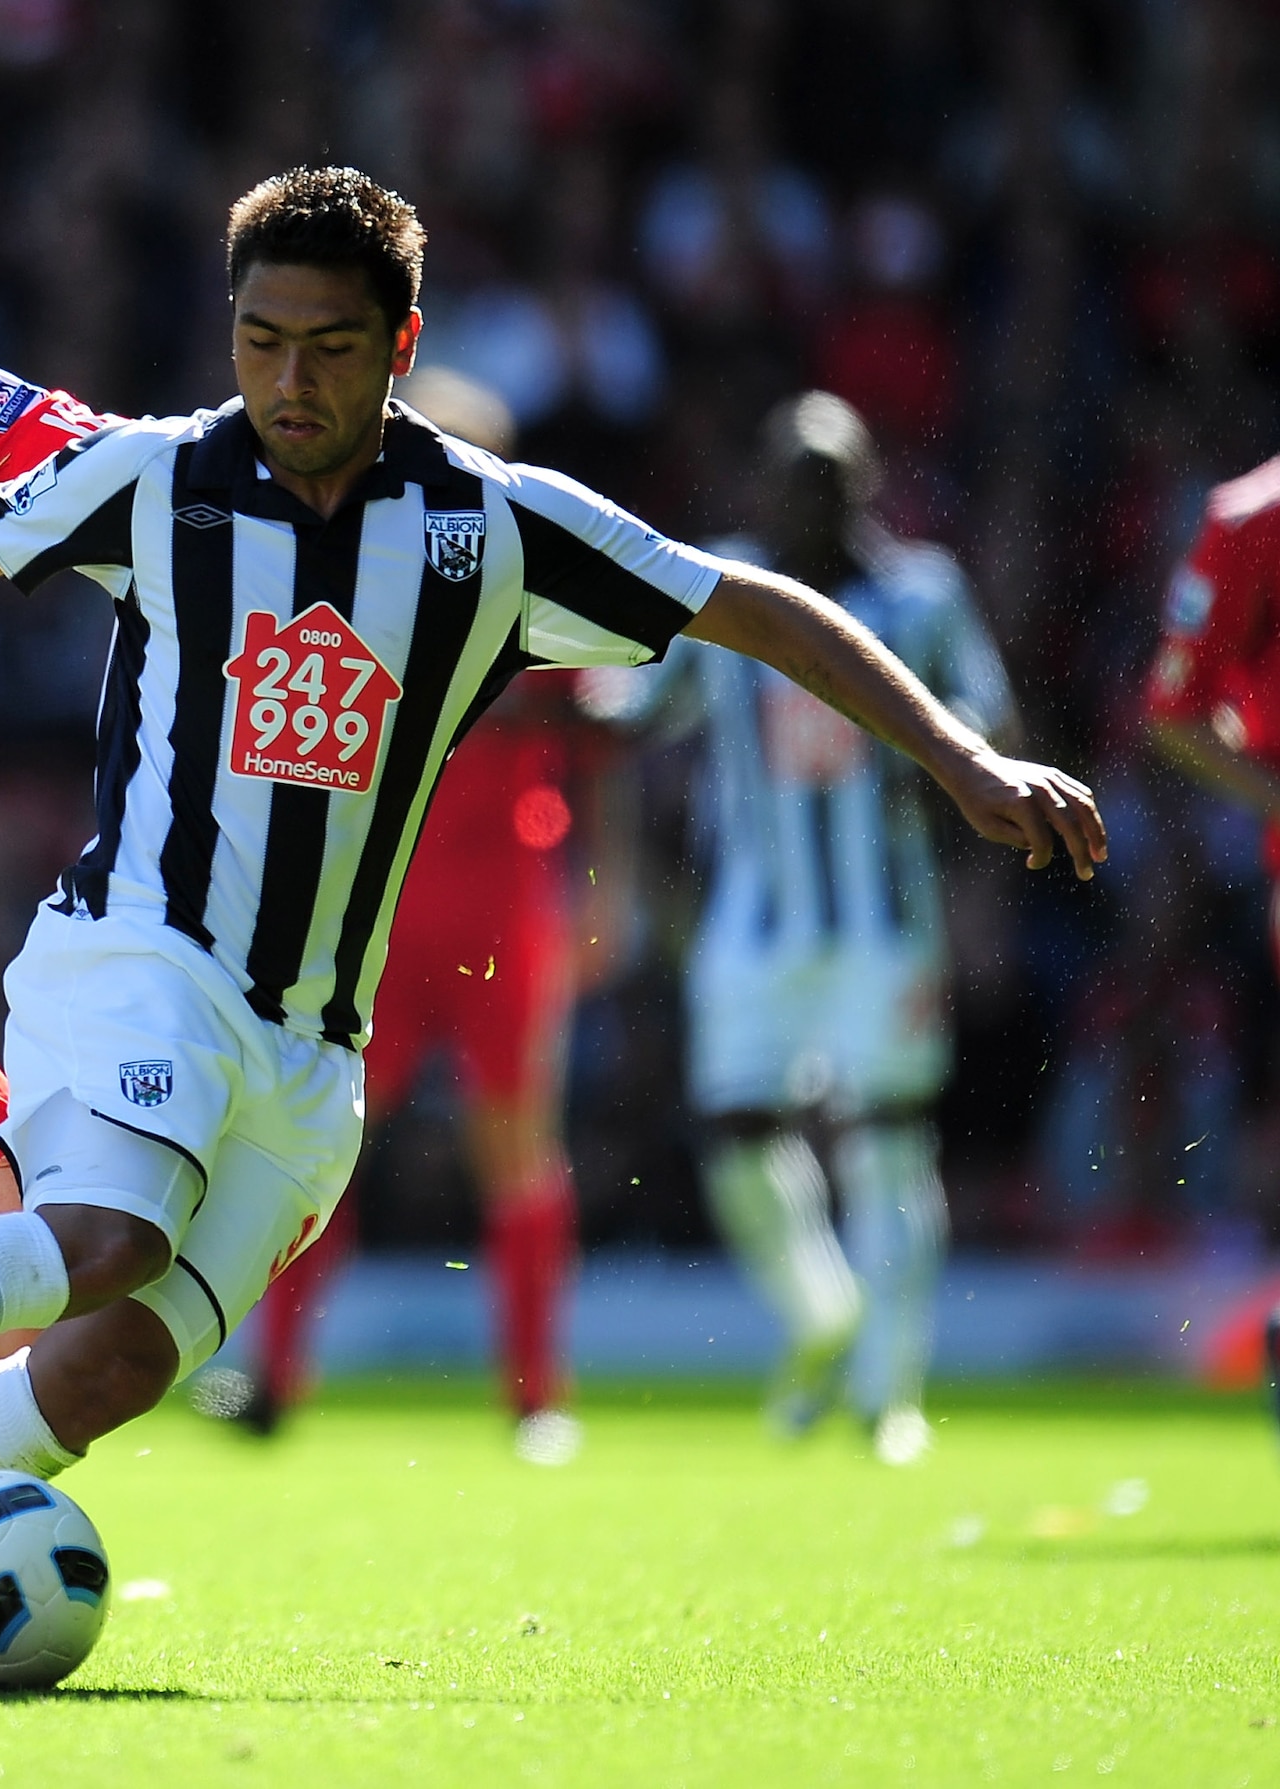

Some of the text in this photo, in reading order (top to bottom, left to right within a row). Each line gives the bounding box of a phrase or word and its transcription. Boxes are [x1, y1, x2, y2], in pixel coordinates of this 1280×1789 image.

[0, 388, 29, 424] BARCLAYS
[428, 520, 483, 533] ALBION
[299, 628, 342, 648] 0800
[249, 699, 369, 762] 999
[244, 751, 361, 787] HomeServe
[123, 1067, 170, 1077] ALBION
